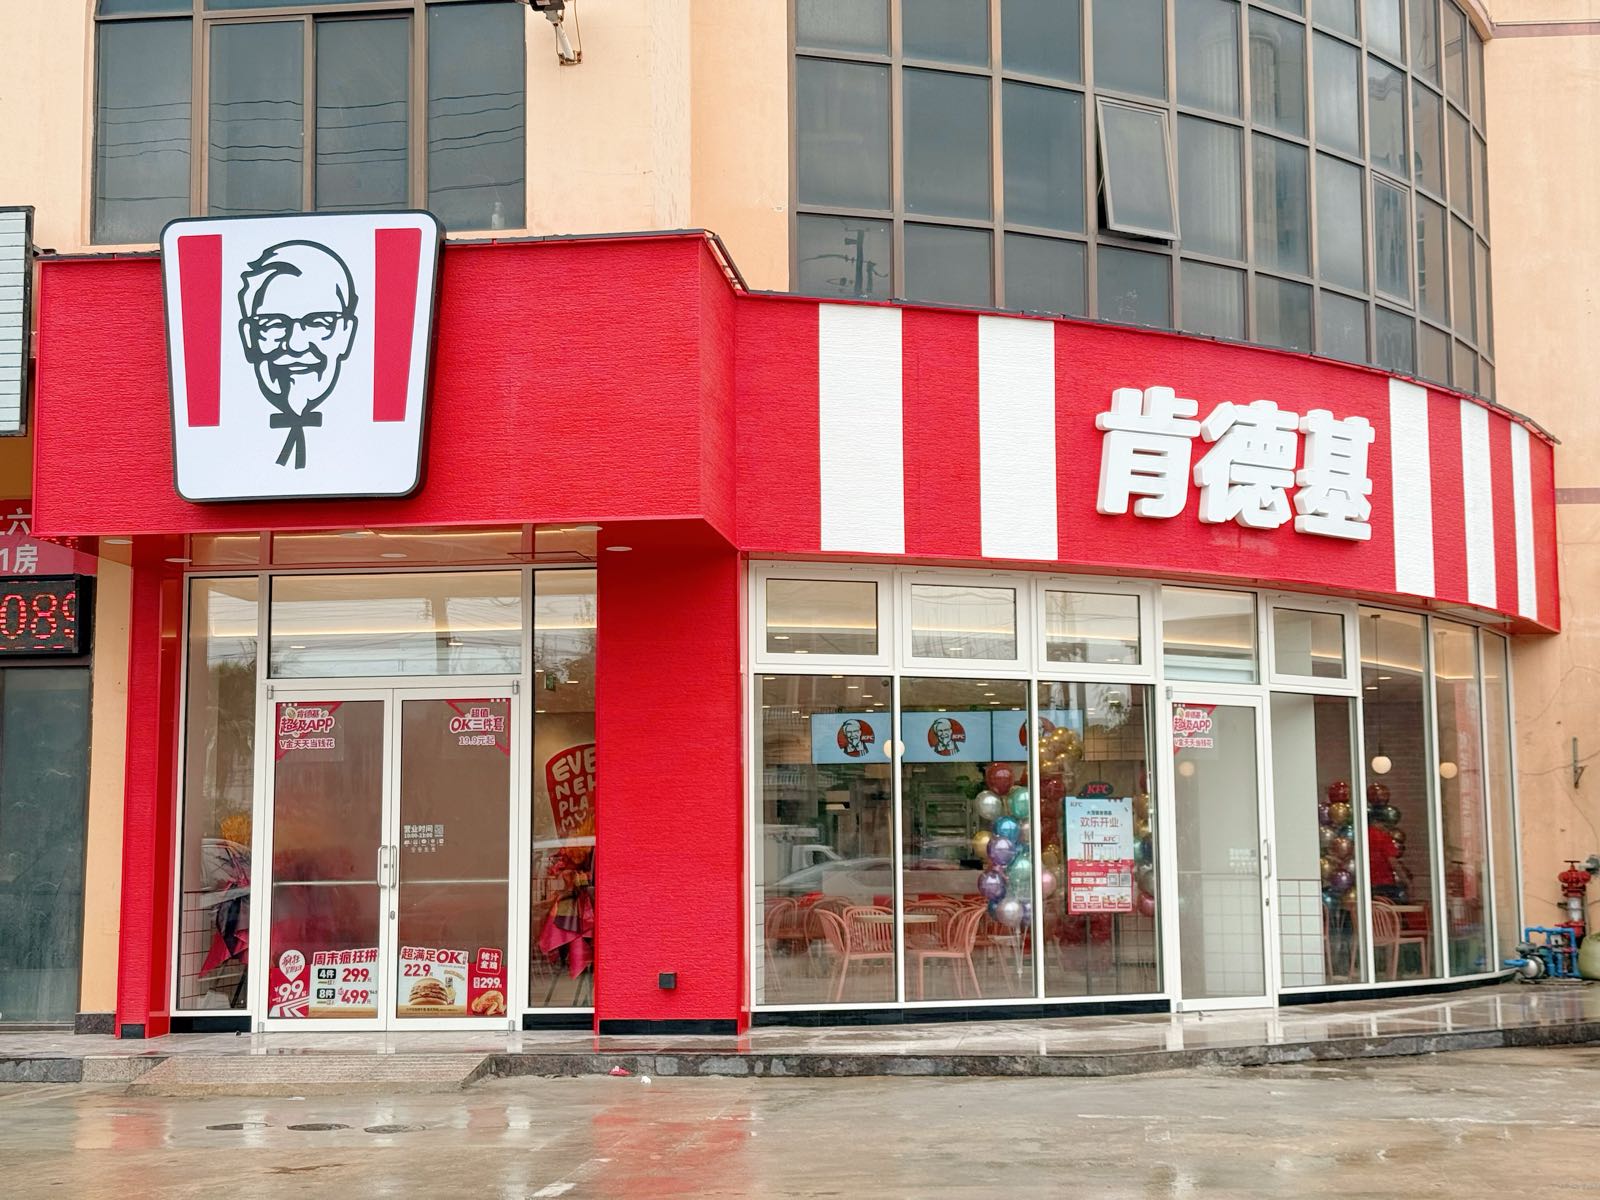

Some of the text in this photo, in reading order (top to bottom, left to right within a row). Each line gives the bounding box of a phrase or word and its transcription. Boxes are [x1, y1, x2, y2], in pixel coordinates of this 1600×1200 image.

[1095, 386, 1375, 541] 肯德基
[297, 709, 319, 719] 肯德基
[471, 708, 489, 718] 超值
[280, 717, 334, 734] 超级APP
[450, 716, 504, 732] OK三件套
[279, 738, 335, 749] V金天天当钱花
[459, 734, 496, 745] 19.9元起
[1086, 783, 1109, 795] KFC
[1080, 816, 1120, 828] 欢乐开业
[404, 824, 434, 833] 营业时间
[312, 948, 378, 967] 周末疯狂拼
[318, 968, 336, 979] 4件
[317, 988, 335, 999] 8件
